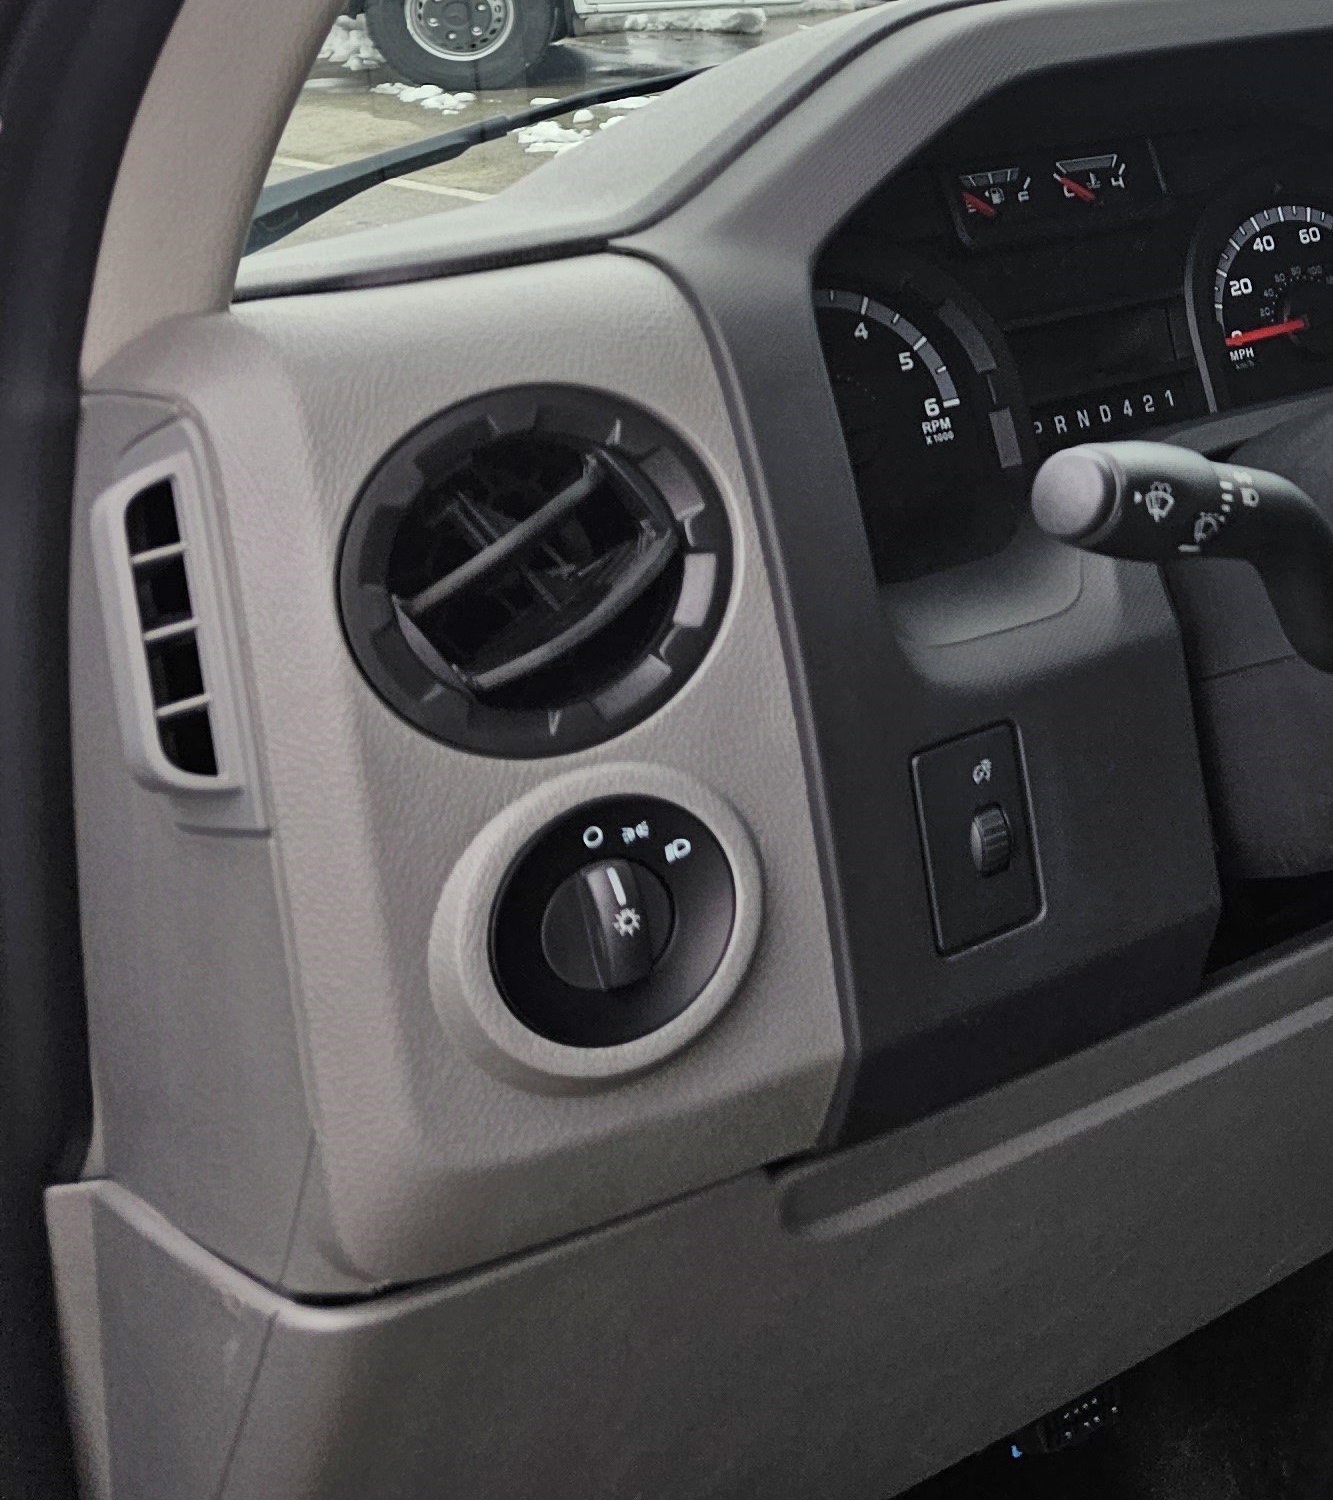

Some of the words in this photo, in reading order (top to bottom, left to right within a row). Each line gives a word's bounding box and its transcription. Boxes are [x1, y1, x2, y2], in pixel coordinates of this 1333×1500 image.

[1018, 190, 1029, 203] F
[1253, 235, 1275, 252] 40
[1299, 226, 1321, 244] 60
[1229, 277, 1253, 297] 20
[854, 322, 869, 340] 4
[898, 352, 914, 372] 5
[1229, 347, 1255, 362] MPH
[924, 397, 940, 417] 6
[1054, 414, 1068, 435] R
[1076, 409, 1090, 429] N
[1099, 404, 1112, 423] D
[1123, 399, 1133, 417] 4
[1142, 394, 1155, 413] 2
[1164, 389, 1174, 407] 1
[922, 417, 952, 435] RPM
